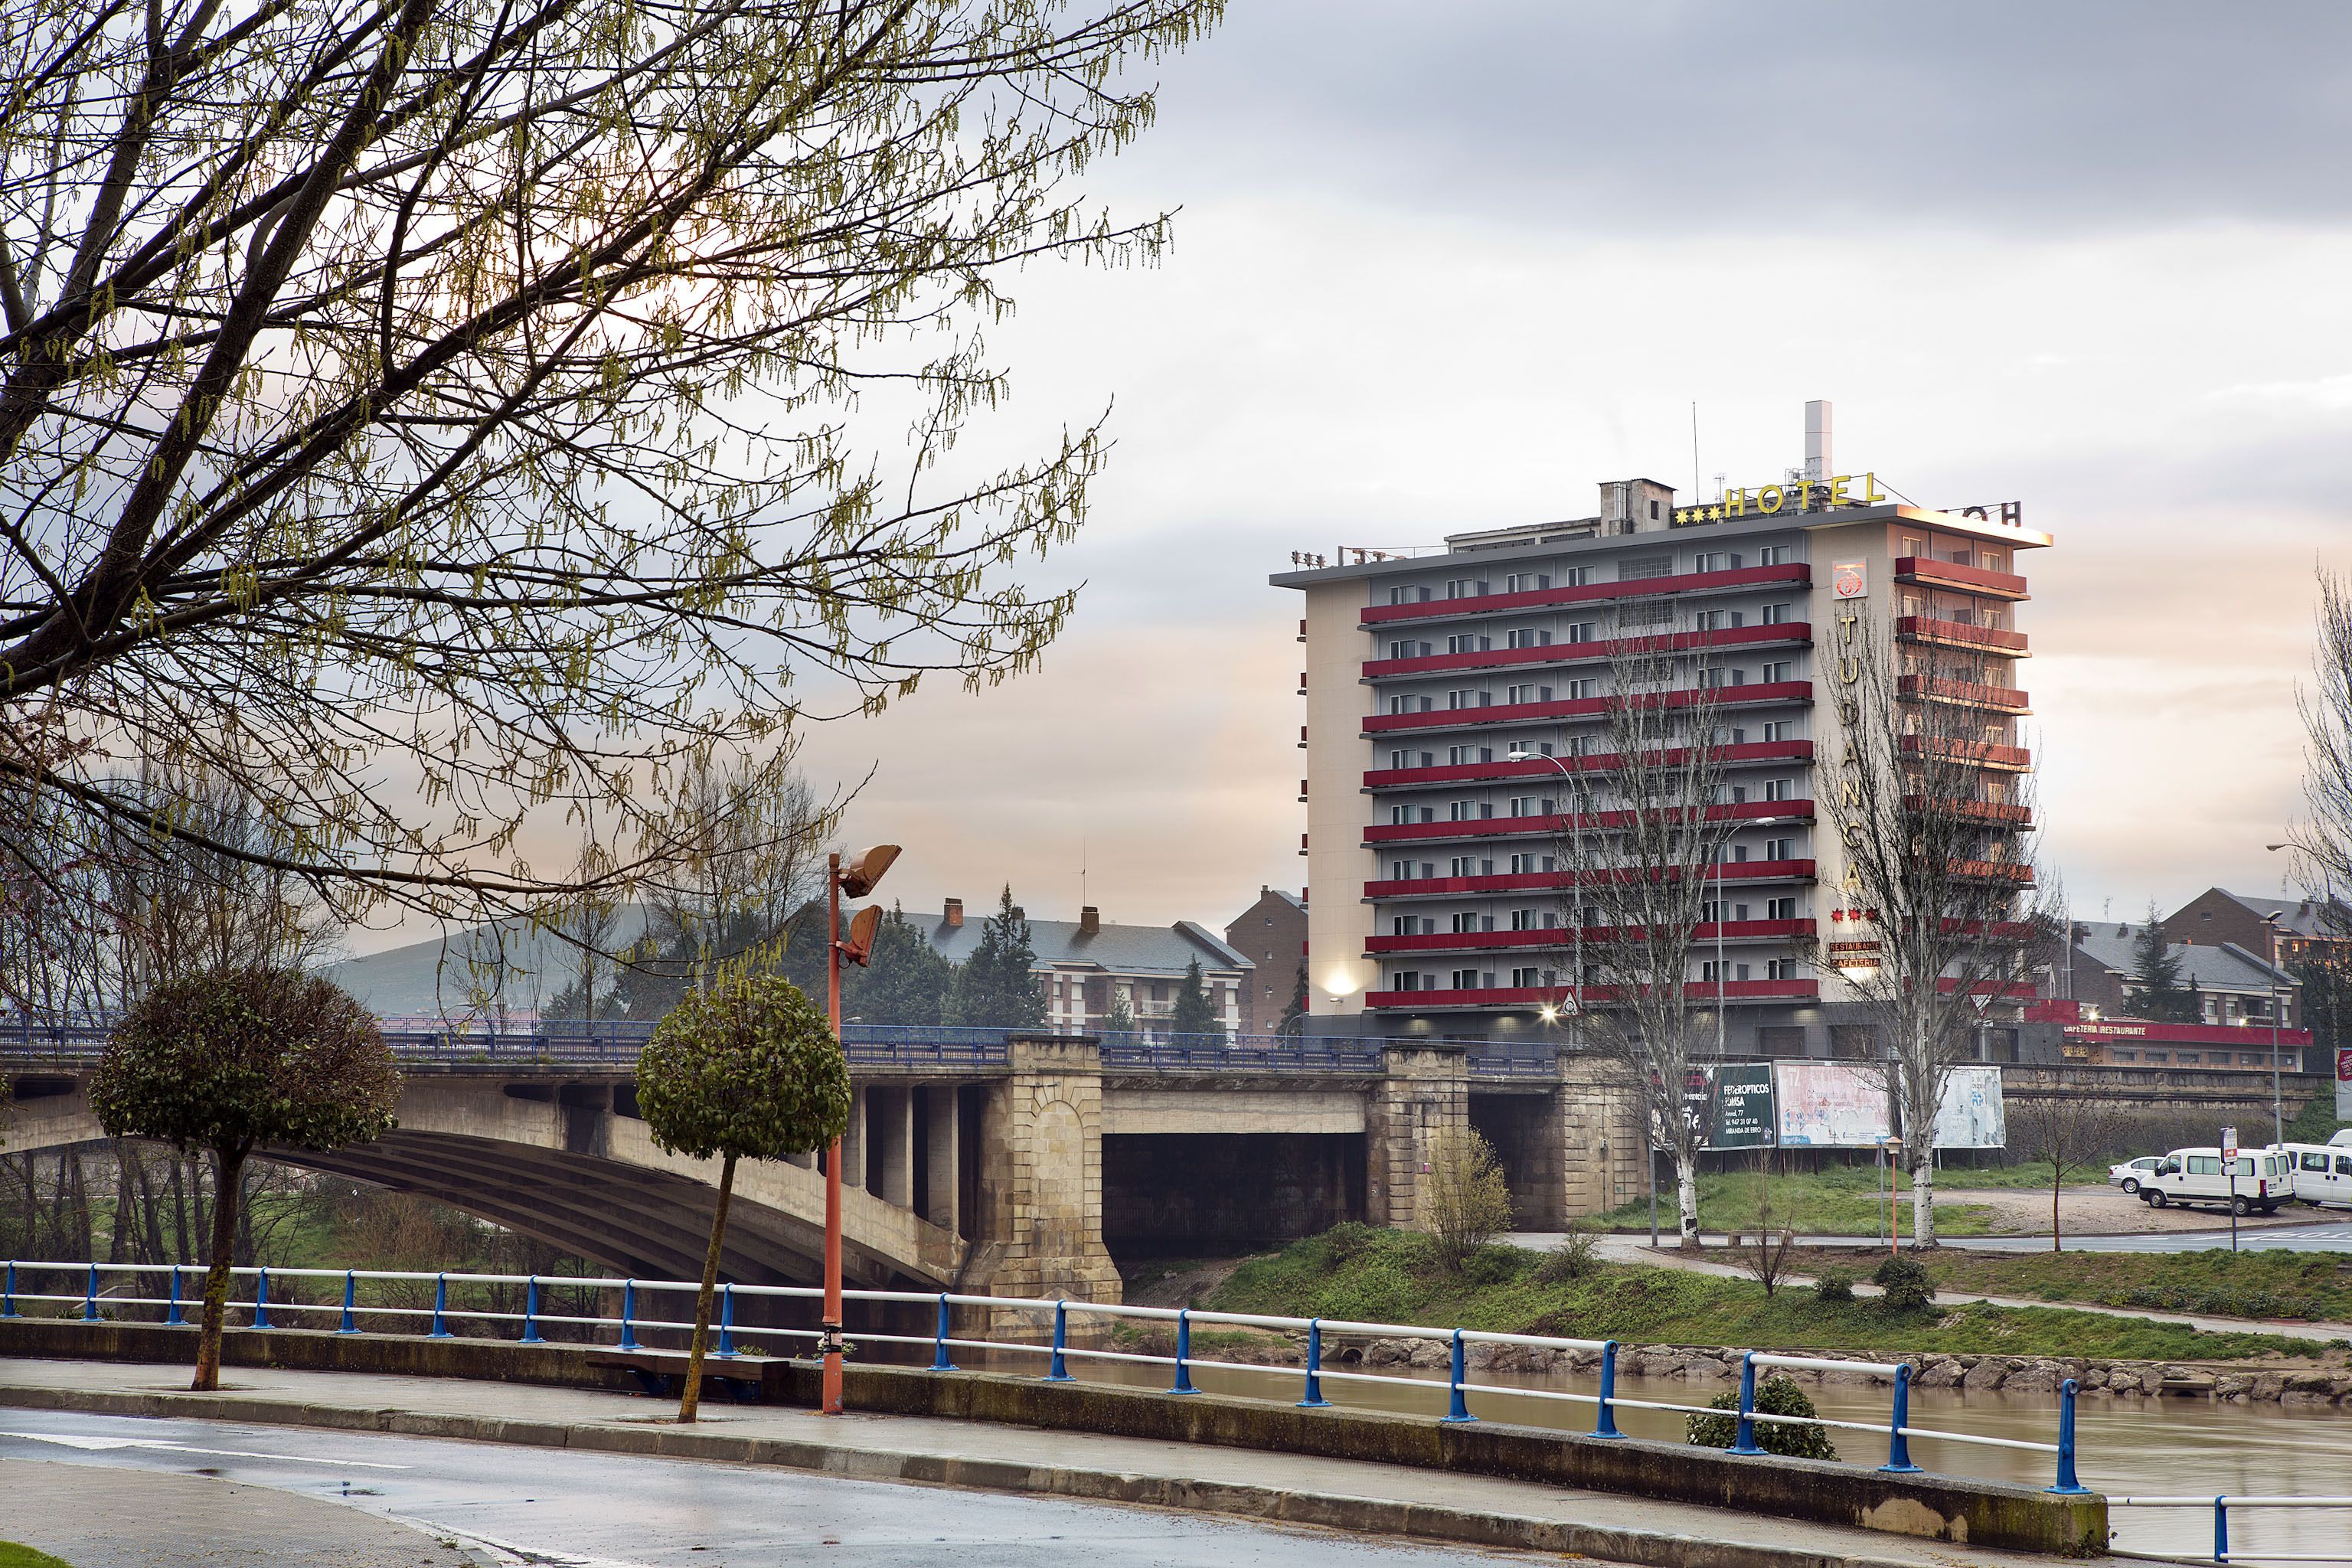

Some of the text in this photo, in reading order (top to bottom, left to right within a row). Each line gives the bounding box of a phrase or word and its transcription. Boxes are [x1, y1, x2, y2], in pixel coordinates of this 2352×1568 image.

[1726, 472, 1885, 518] HOTEL
[1838, 616, 1864, 890] TUDANCA
[1830, 942, 1880, 951] RESTAURANTE
[1831, 959, 1879, 968] CAFETERIA
[2063, 1024, 2146, 1035] CAFETERIA RESTAURANTE
[1723, 1083, 1769, 1095] FEDEROPTICOS
